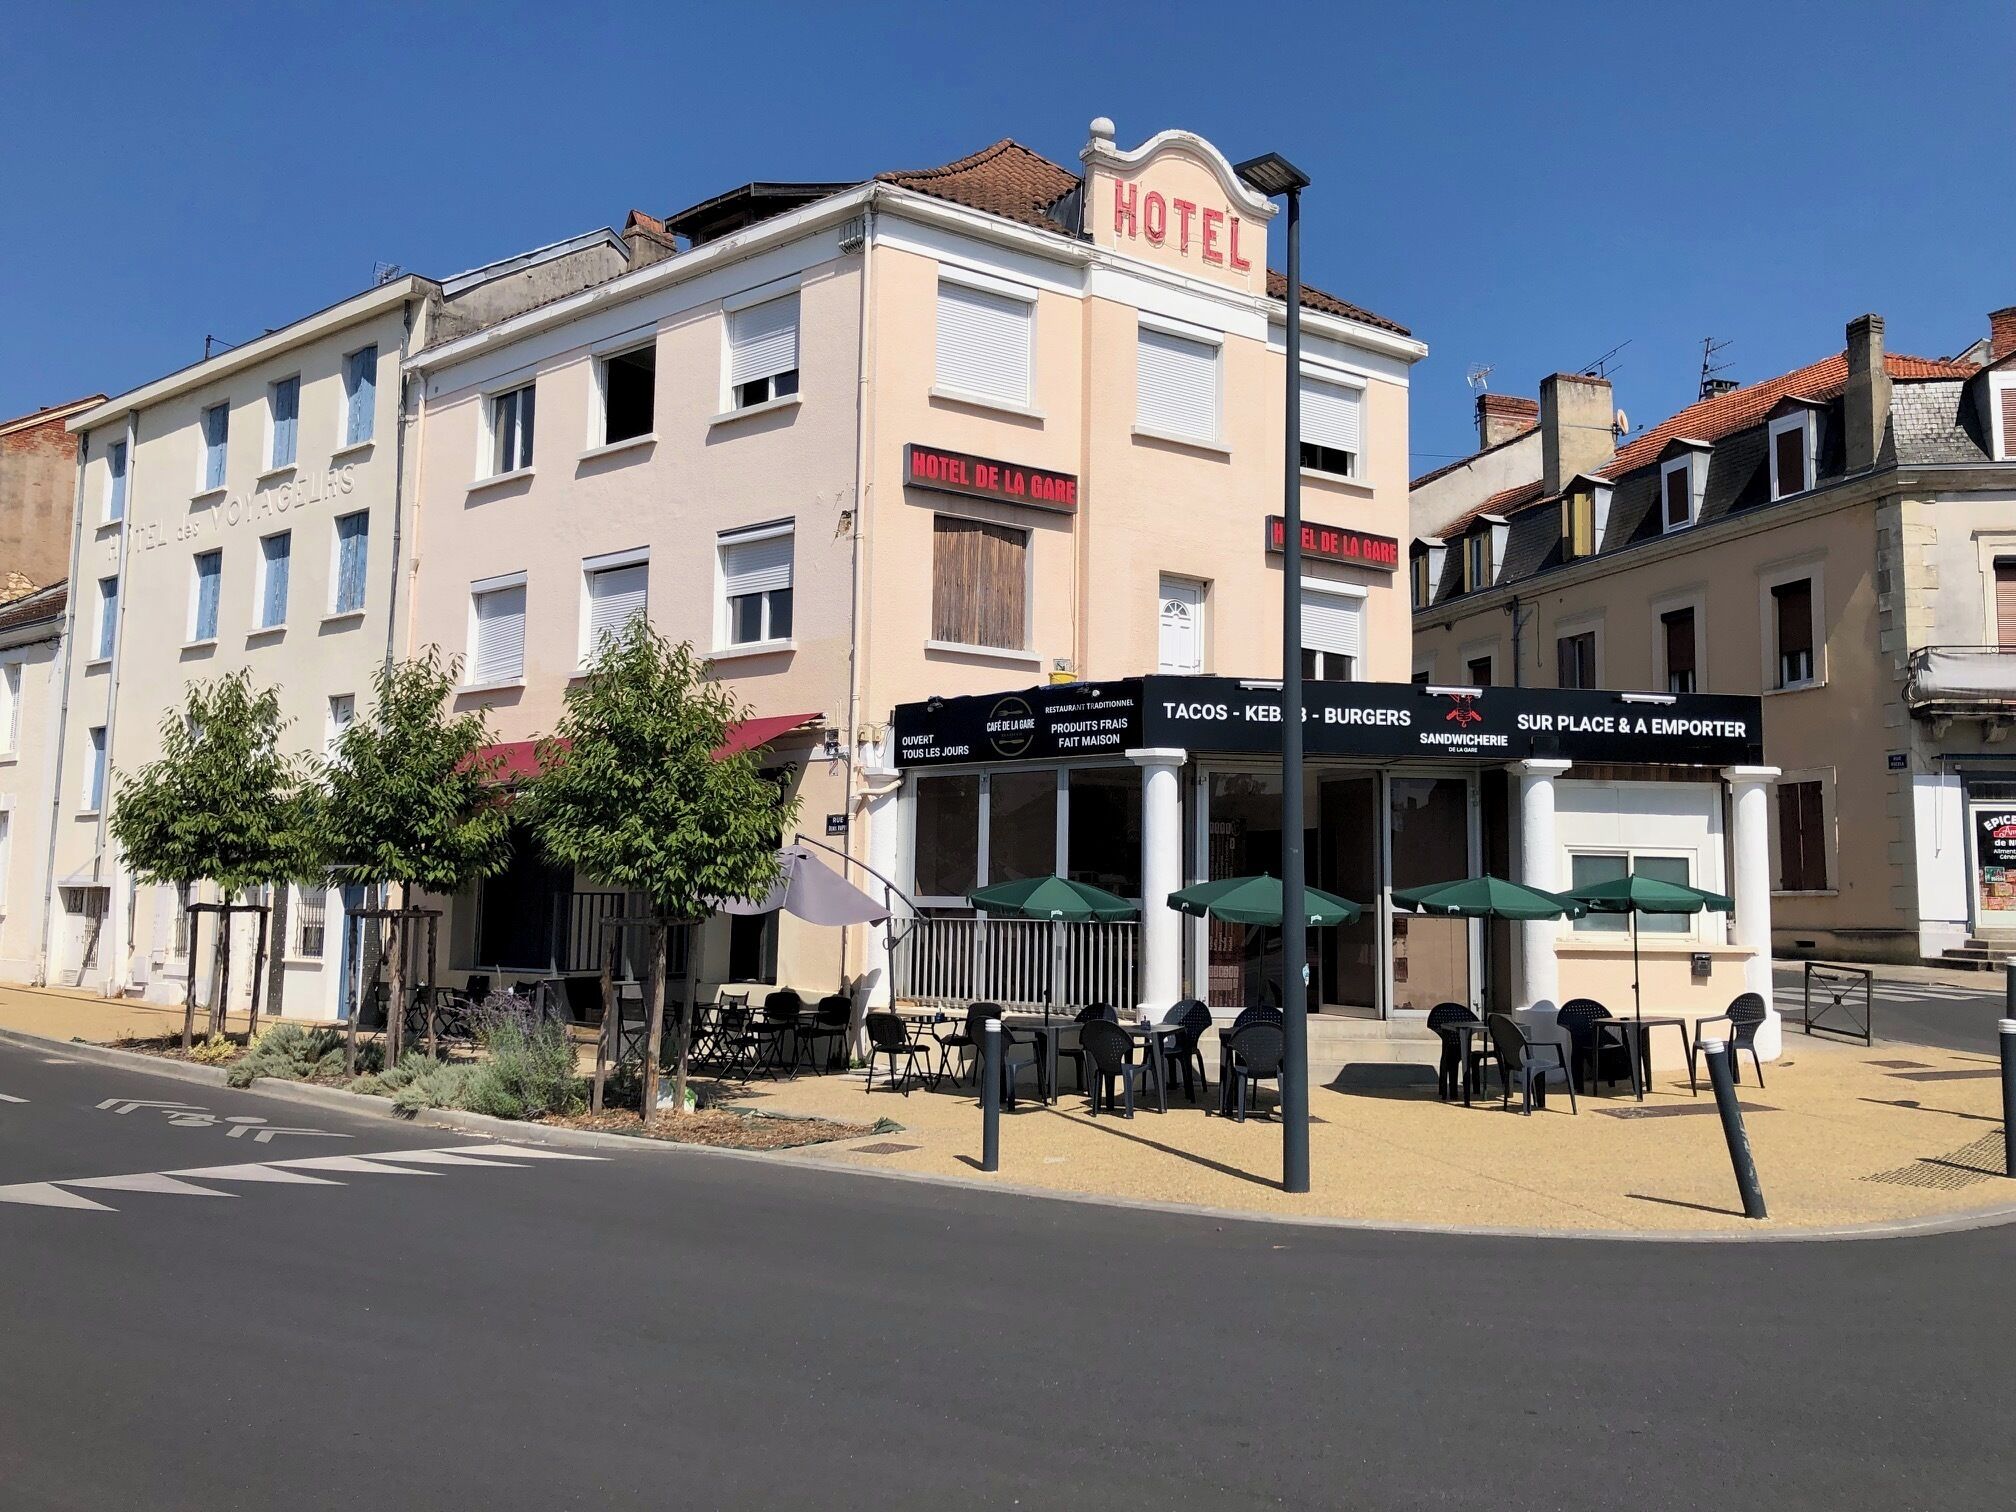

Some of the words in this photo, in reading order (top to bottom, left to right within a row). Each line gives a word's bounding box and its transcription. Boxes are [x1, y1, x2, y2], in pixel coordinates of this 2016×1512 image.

[1115, 178, 1250, 272] HOTEL
[913, 452, 969, 485] HOTEL
[976, 464, 998, 490] DE
[1005, 470, 1024, 496] LA
[1031, 475, 1076, 504] GARE
[177, 513, 200, 541] des
[212, 463, 356, 531] VOYAGEURS
[1274, 522, 1316, 550] HEL
[1321, 532, 1338, 553] DE
[1343, 536, 1359, 557] LA
[1363, 539, 1396, 563] GARE
[1045, 704, 1086, 714] RESTAURANT
[1086, 699, 1134, 710] TRADITIONNEL
[1163, 703, 1228, 720] TACOS
[1324, 708, 1411, 726] BURGERS
[986, 720, 1001, 732] CAFÉ
[1002, 721, 1010, 731] DE
[1011, 720, 1018, 730] LA
[1020, 719, 1035, 730] GARE
[1051, 720, 1098, 734] PRODUITS
[1100, 718, 1128, 730] FRAIS
[1517, 714, 1554, 731] SUR
[1558, 716, 1614, 733] PLACE
[1618, 718, 1630, 733] &
[1634, 718, 1648, 734] A
[1652, 718, 1746, 738] EMPORTER
[902, 734, 934, 746] OUVERT
[1059, 737, 1079, 748] FAIT
[1082, 734, 1120, 746] MAISON
[1420, 733, 1508, 746] SANDWICHERIE
[903, 749, 926, 759] TOUS
[927, 748, 940, 757] LES
[942, 746, 969, 756] JOURS
